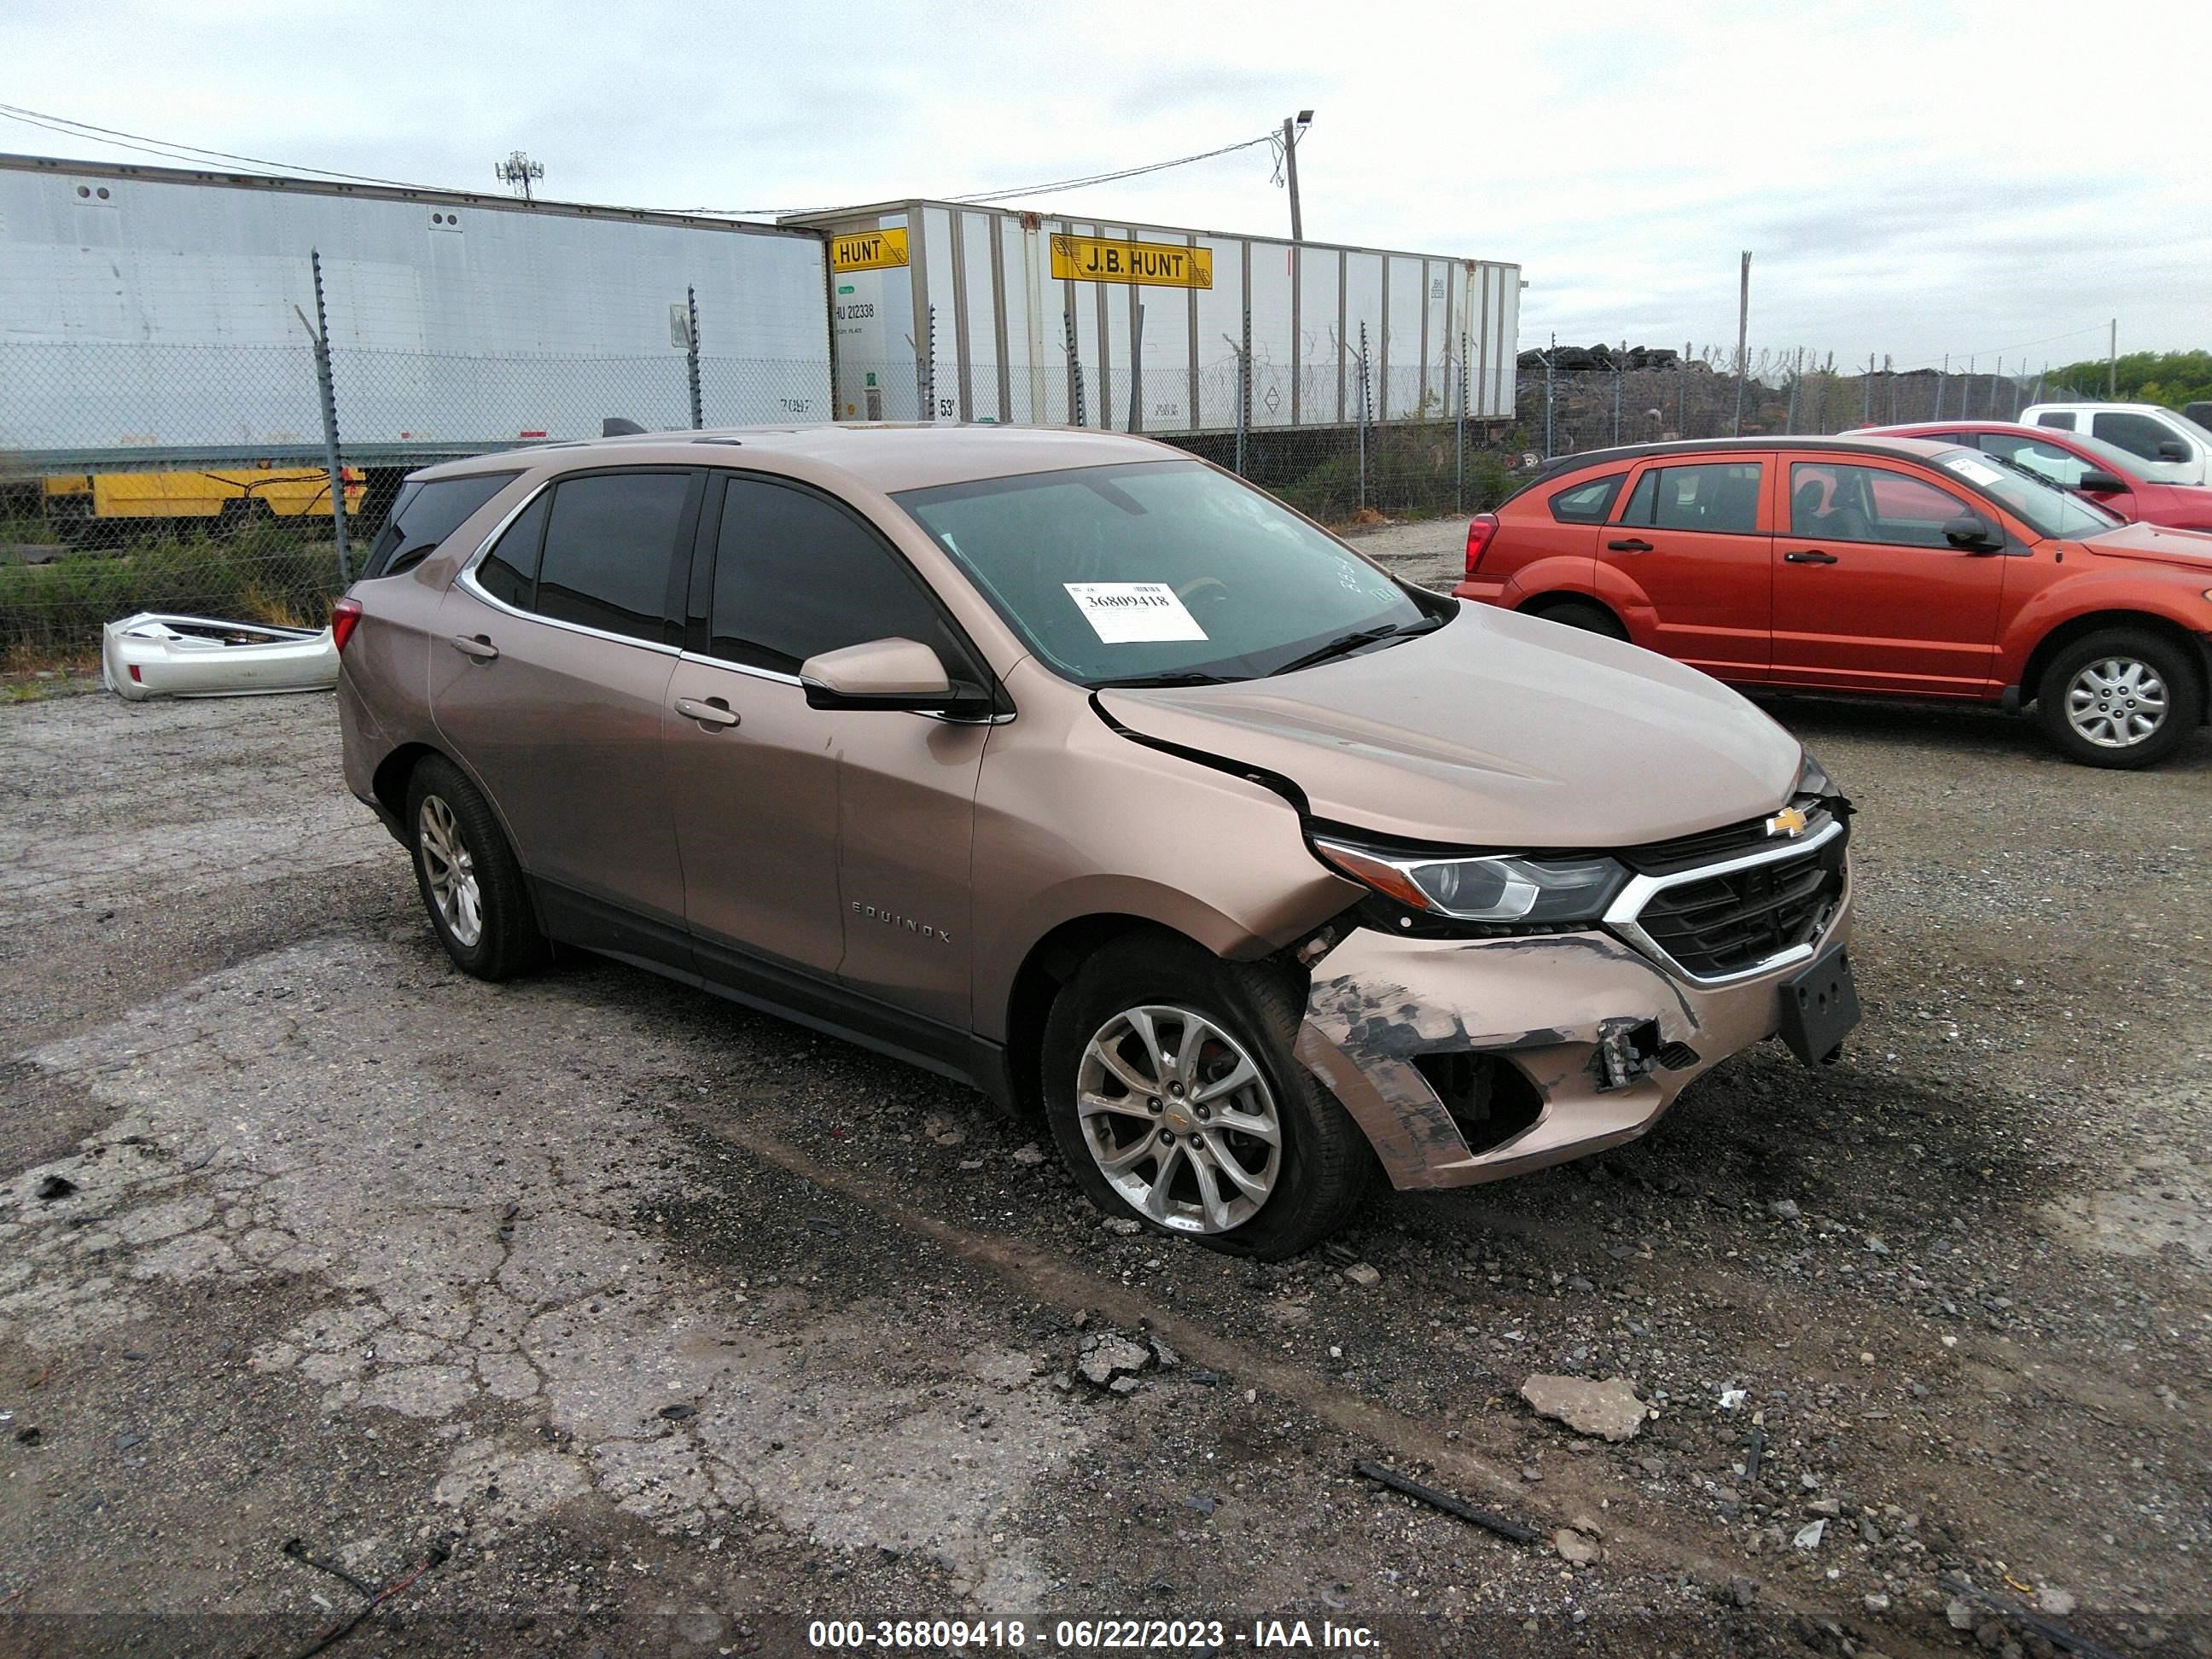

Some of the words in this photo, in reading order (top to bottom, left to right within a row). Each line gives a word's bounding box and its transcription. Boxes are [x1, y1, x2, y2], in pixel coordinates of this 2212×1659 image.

[840, 240, 881, 264] HUNT
[1086, 247, 1125, 274] J.B.
[1130, 250, 1183, 277] HUNT
[847, 303, 875, 319] 212338
[1086, 595, 1170, 608] 36809418
[852, 900, 951, 944] EQUINOX
